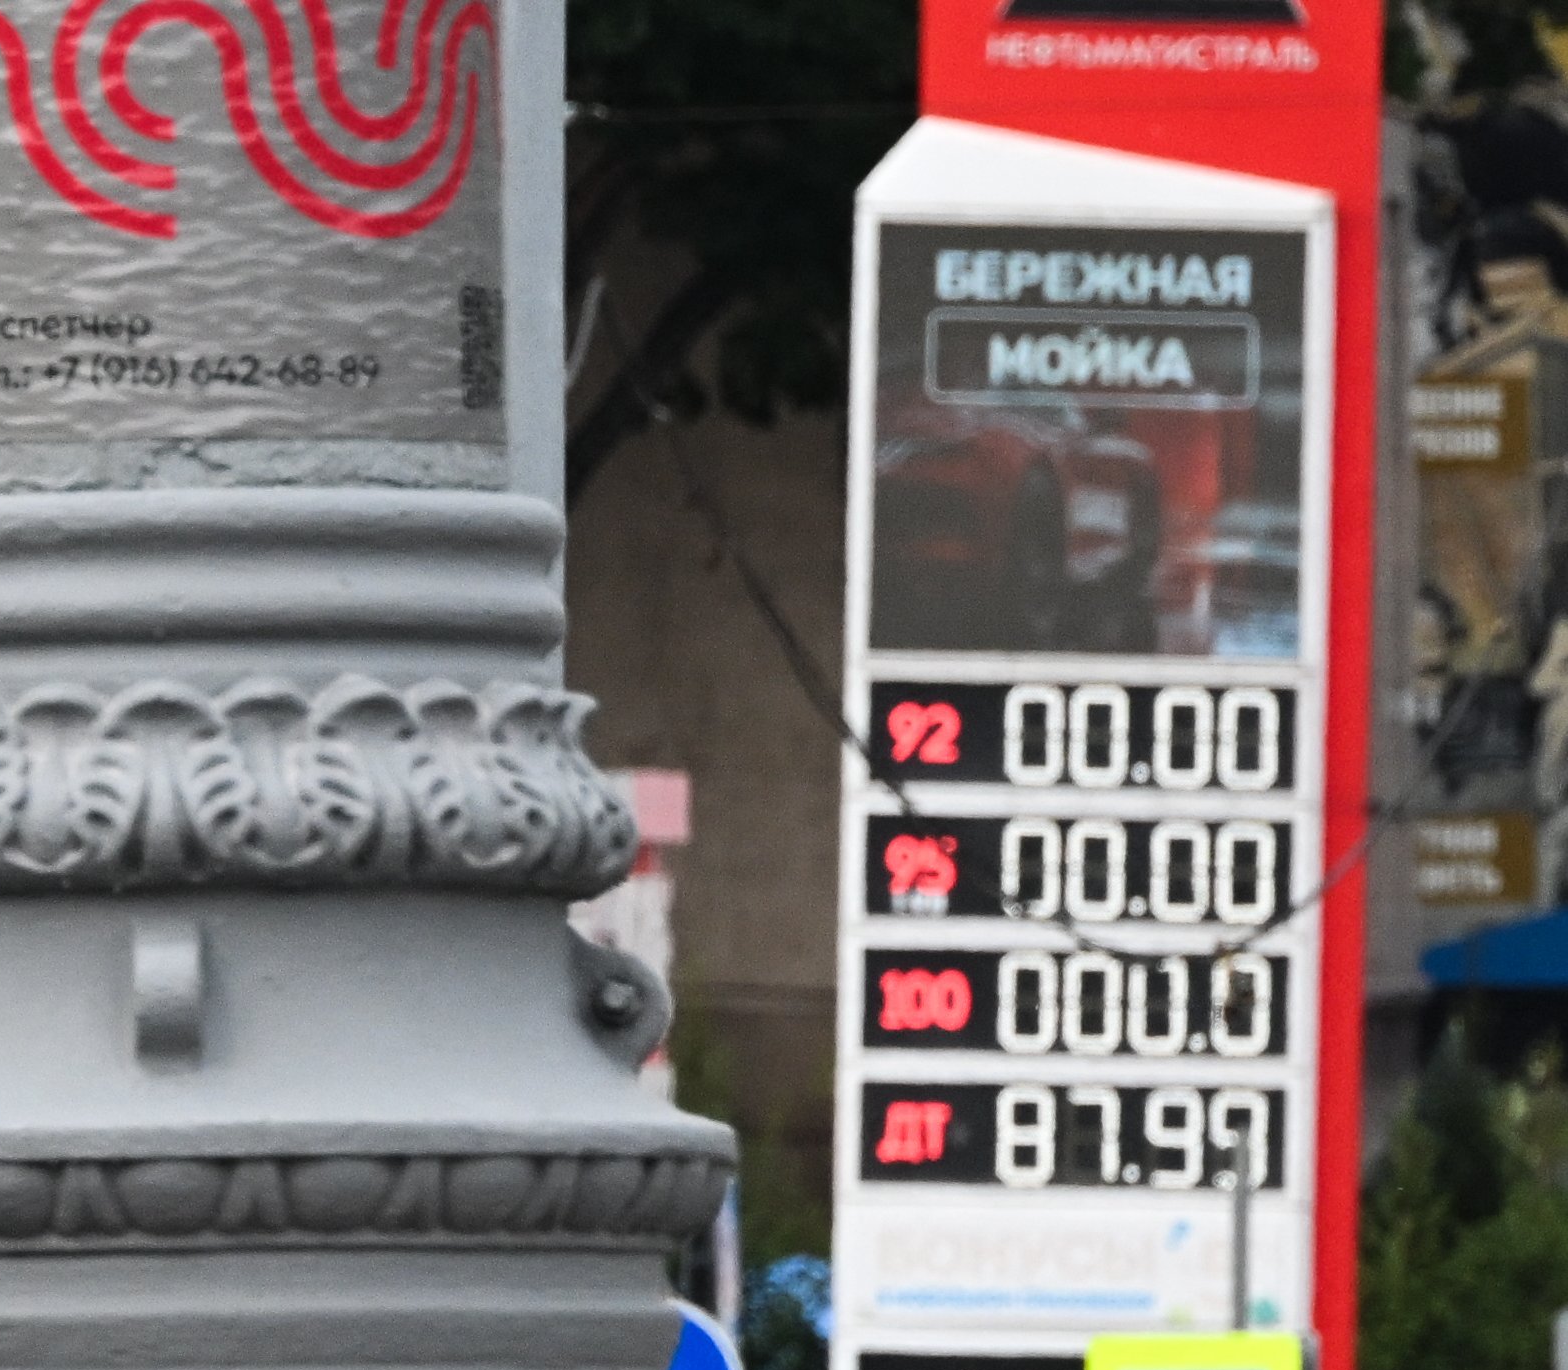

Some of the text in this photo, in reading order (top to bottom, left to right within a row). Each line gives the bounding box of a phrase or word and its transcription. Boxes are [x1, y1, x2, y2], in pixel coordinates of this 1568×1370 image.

[985, 32, 1320, 73] НЕФТЬМАГИСТРАЛЬ
[935, 249, 1253, 306] БЕРЕЖНАЯ
[190, 353, 380, 388] 642-68-89
[988, 326, 1195, 388] МОЙКА
[887, 685, 1280, 790] 92 00.00
[884, 834, 958, 895] 95
[879, 968, 973, 1032] 100
[876, 1101, 952, 1164] ДТ
